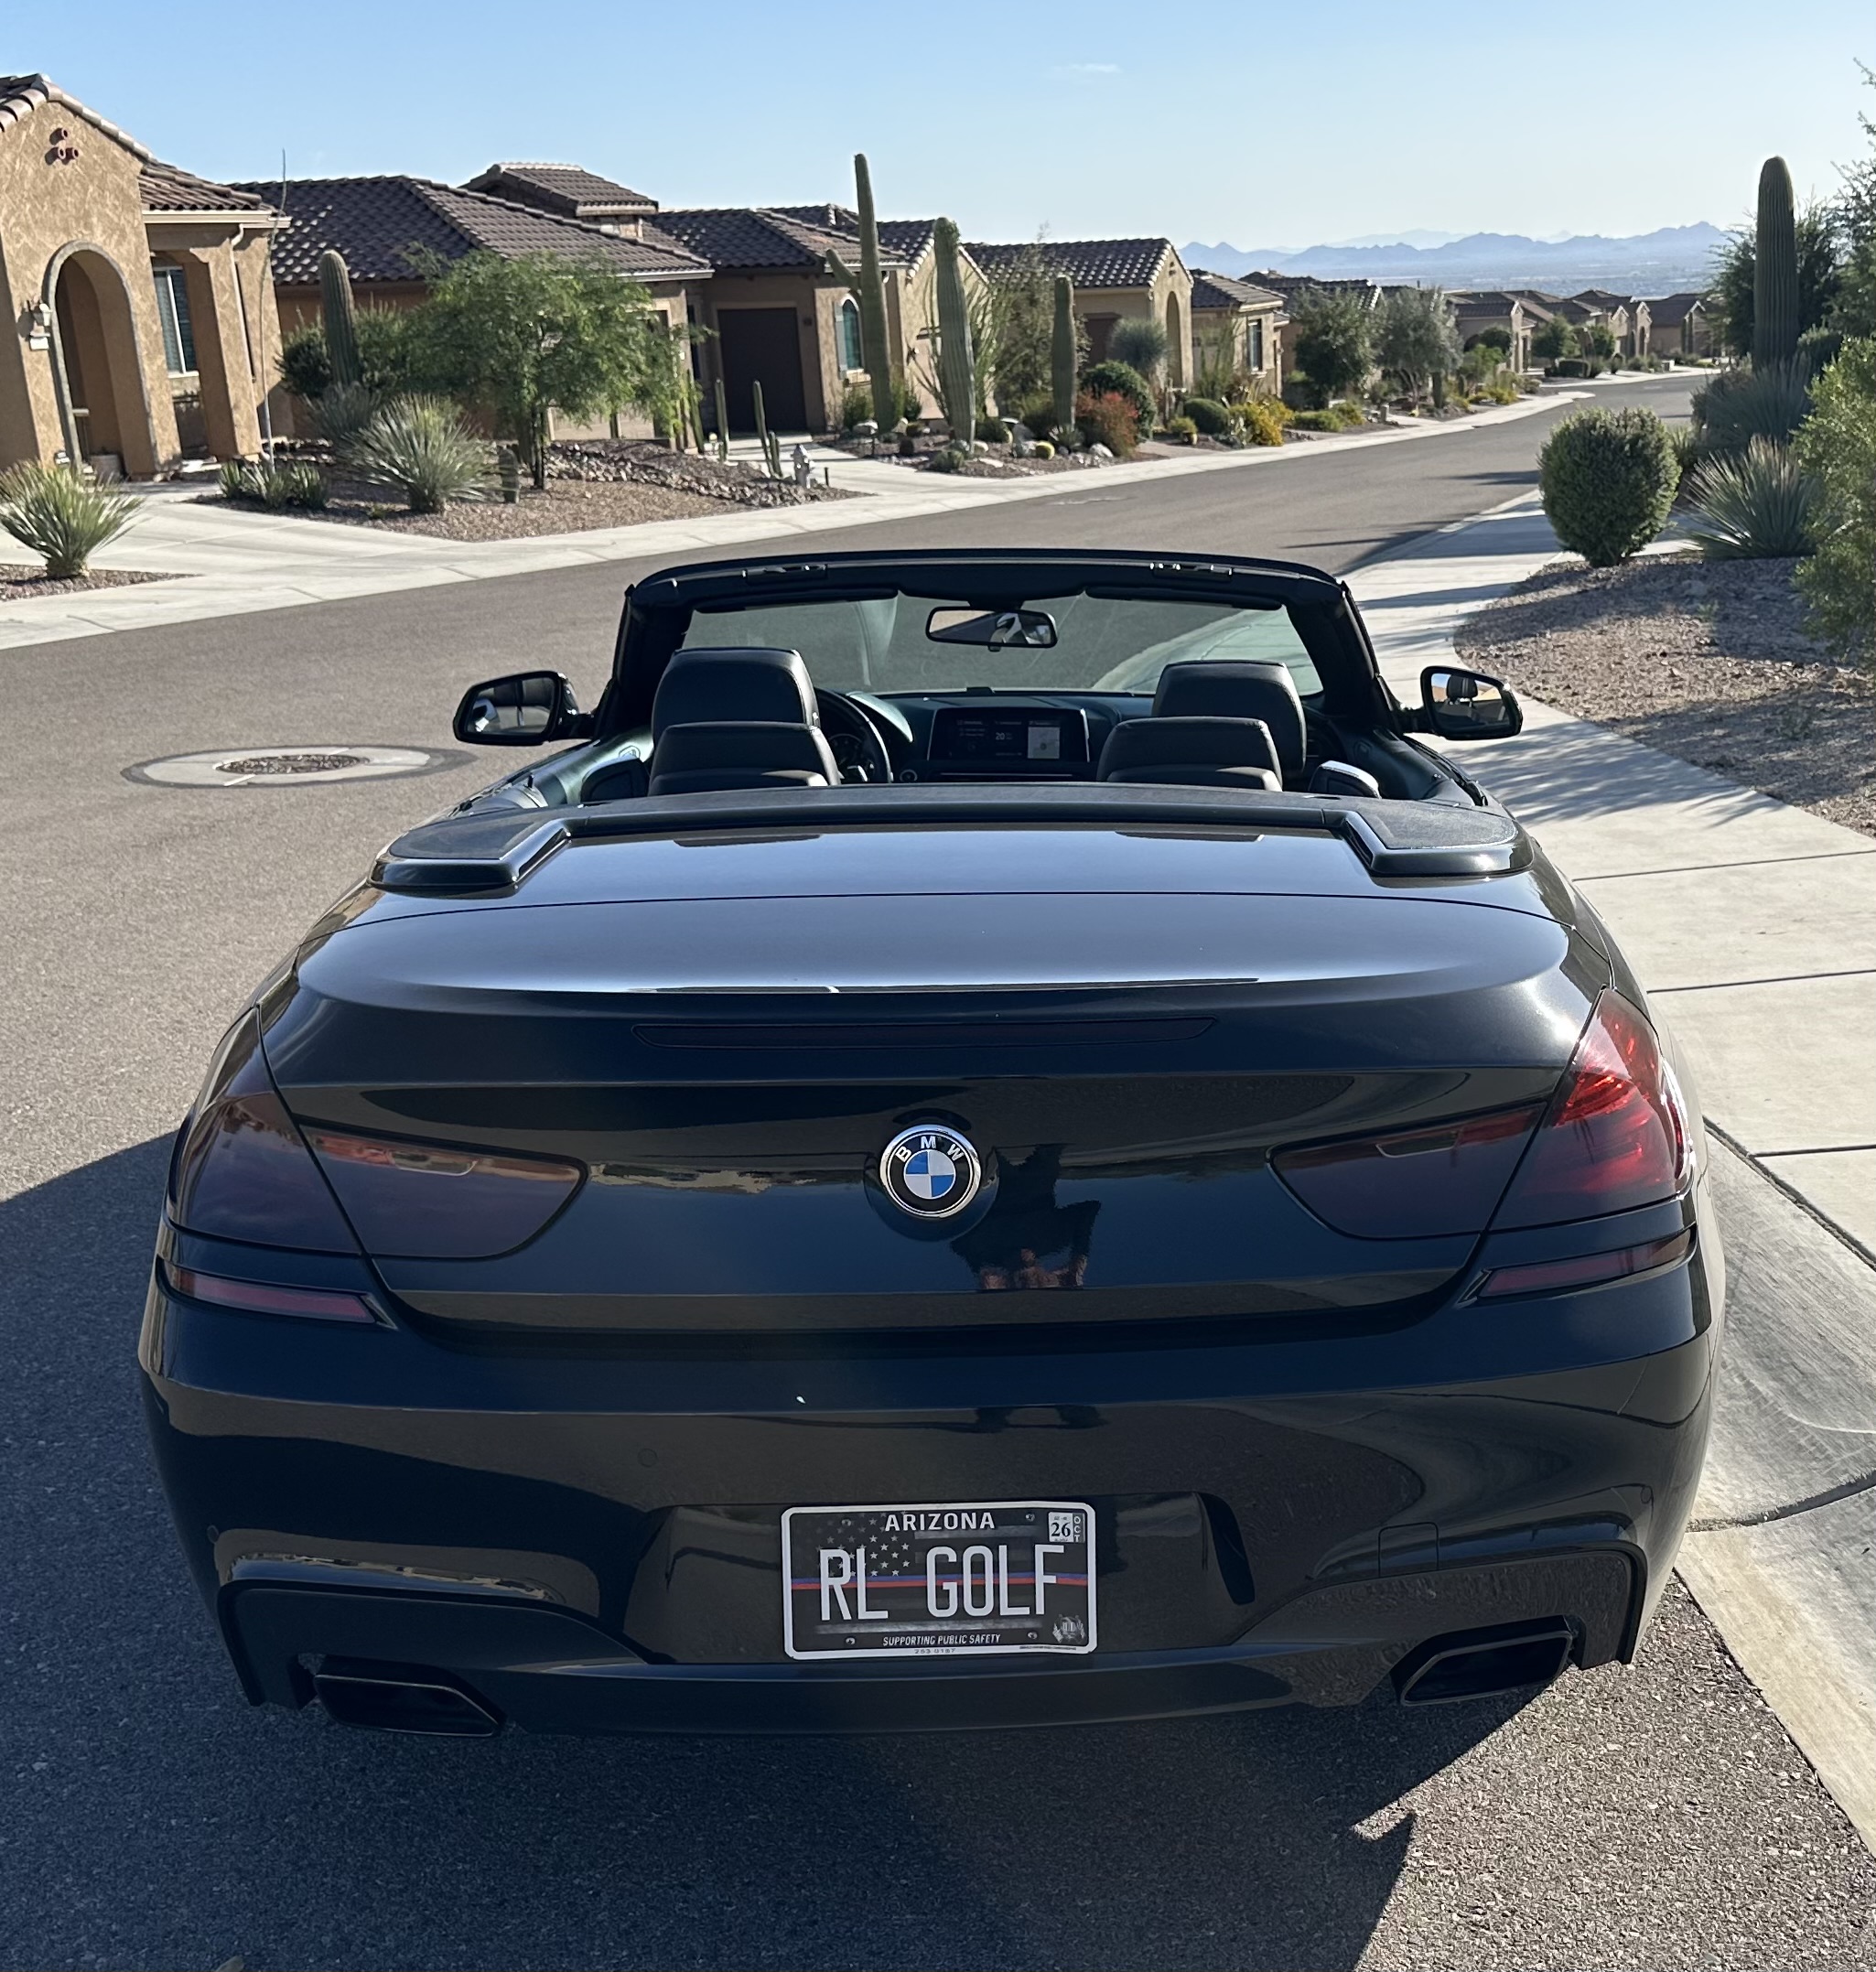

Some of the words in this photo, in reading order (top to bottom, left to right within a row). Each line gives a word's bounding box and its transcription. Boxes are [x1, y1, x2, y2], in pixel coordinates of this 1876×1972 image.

[895, 1136, 965, 1163] BMW
[885, 1512, 996, 1532] ARIZONA
[1051, 1522, 1071, 1537] 26
[1073, 1515, 1082, 1543] OCT
[820, 1547, 889, 1621] RL
[926, 1544, 1065, 1618] GOLF
[882, 1635, 935, 1647] SUPPORTING
[937, 1633, 967, 1645] PUBLIC
[969, 1633, 1001, 1644] SAFETY
